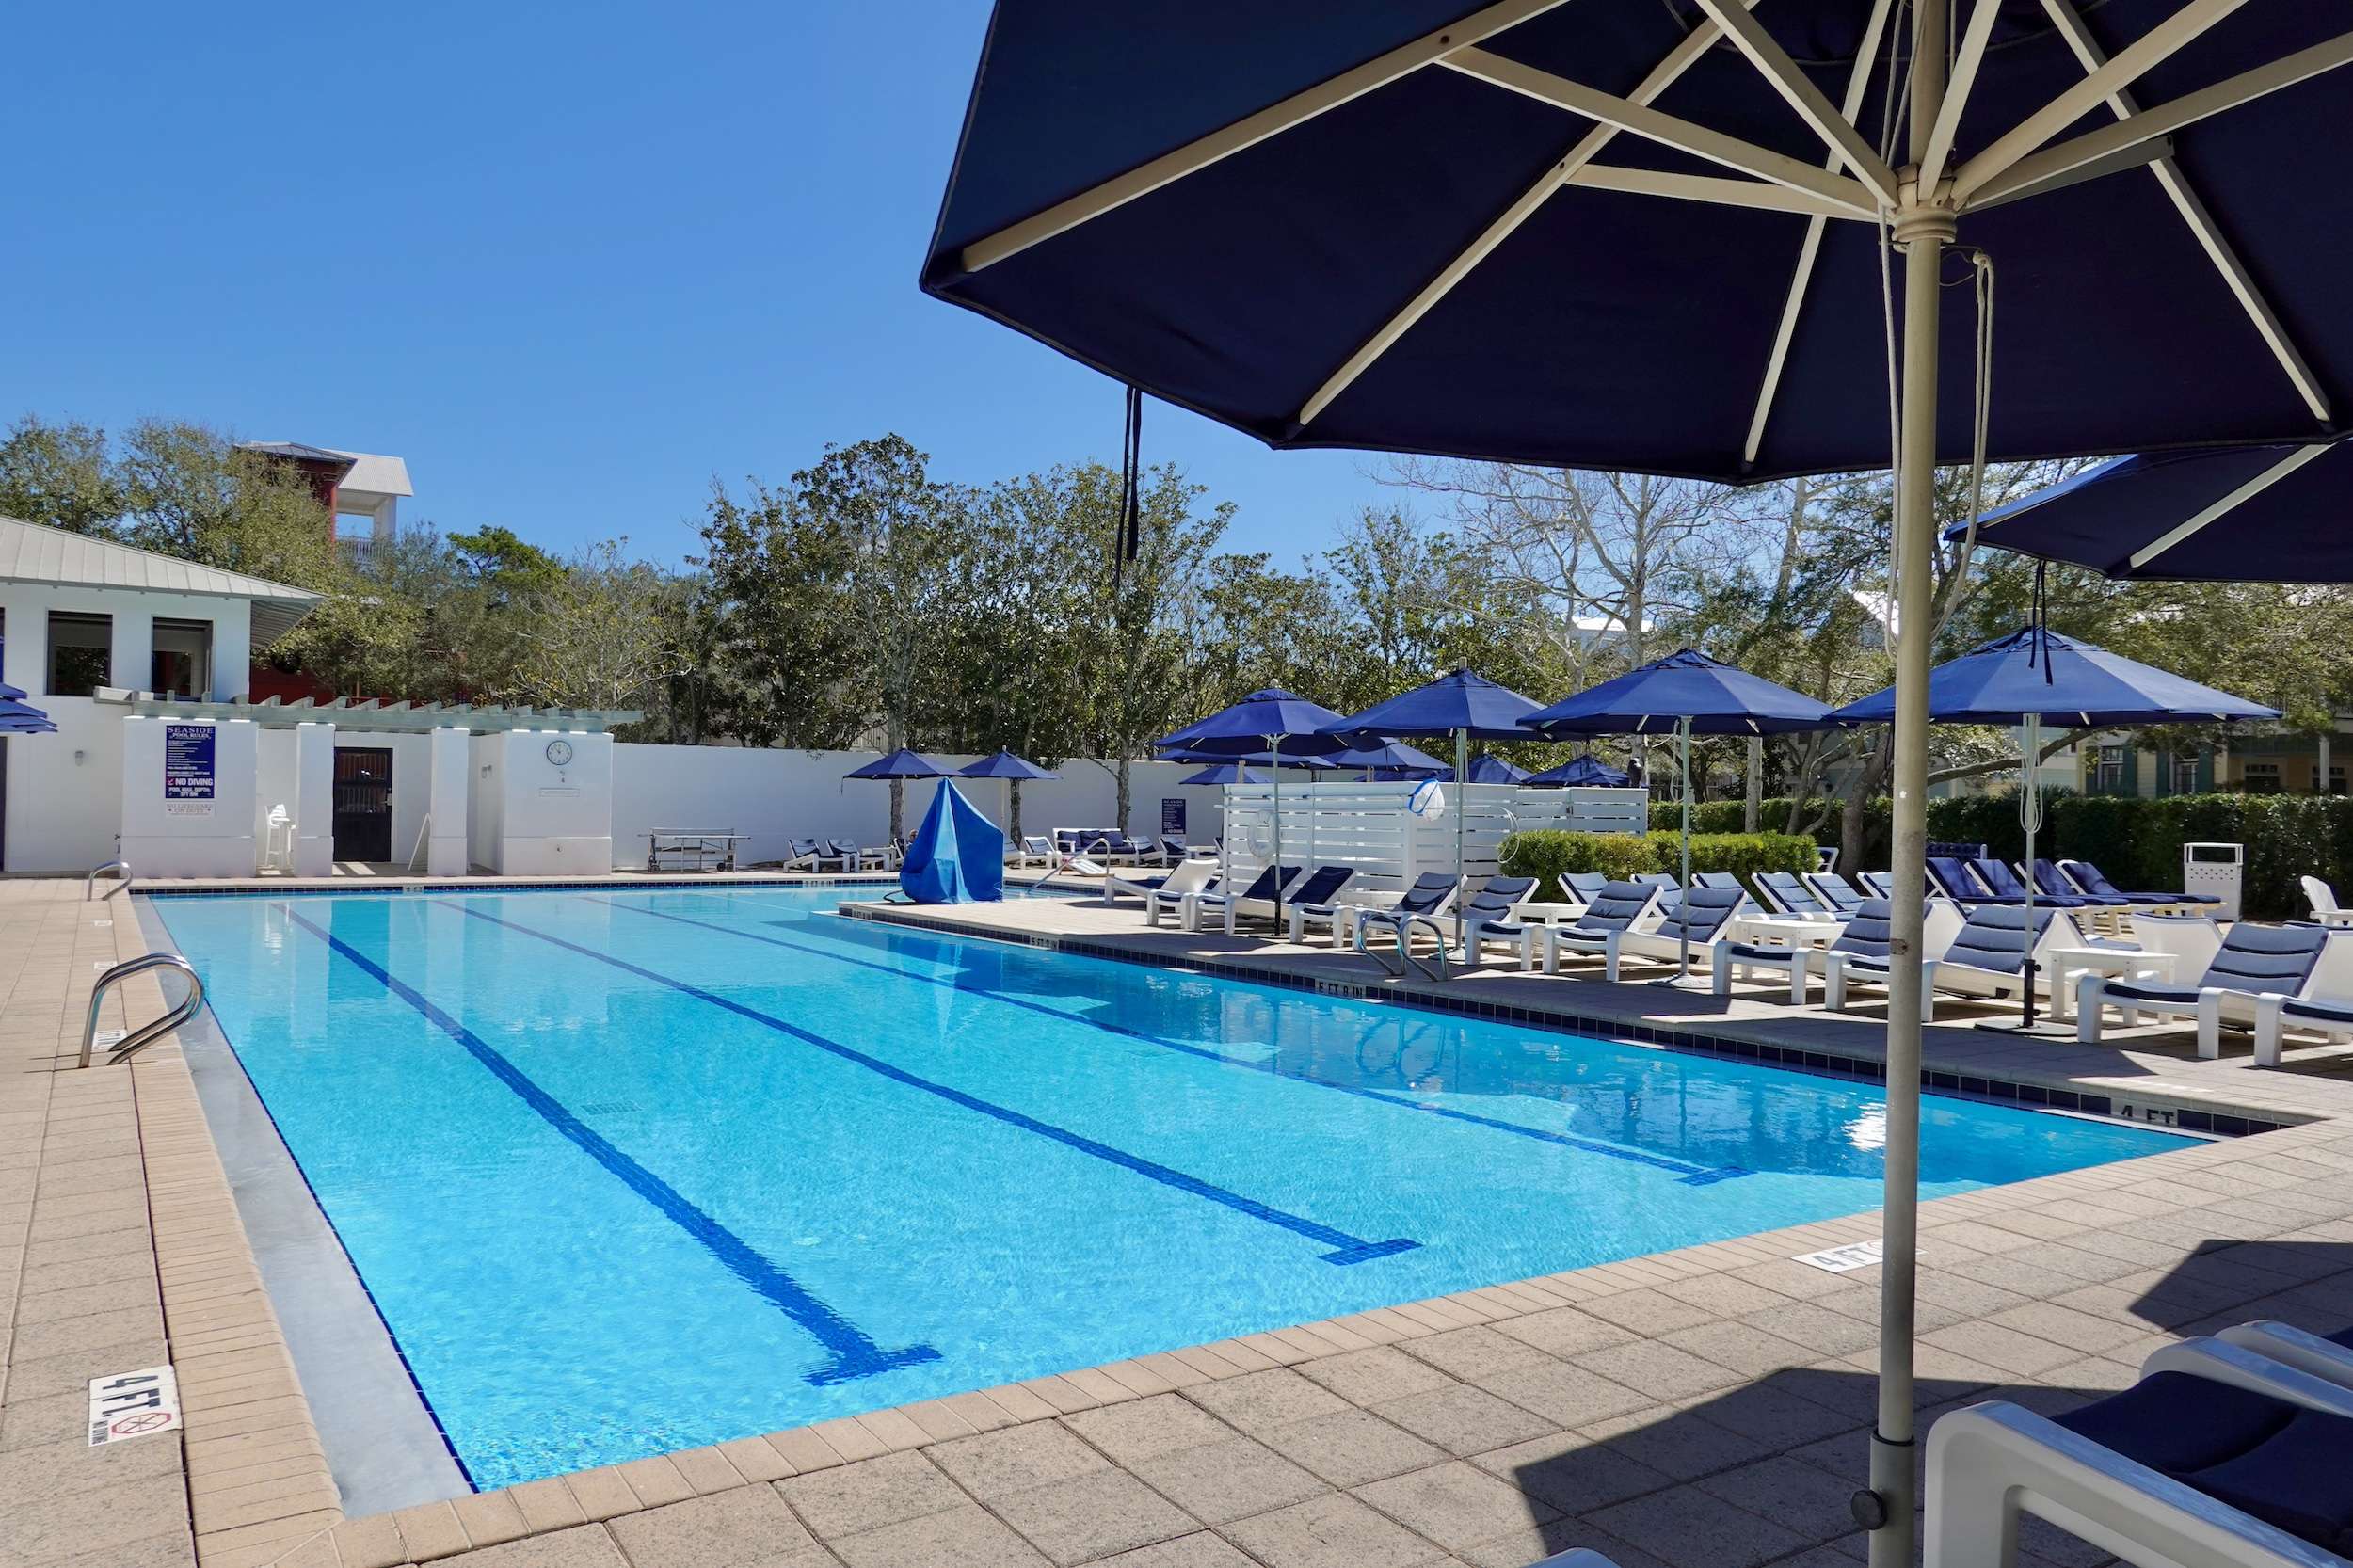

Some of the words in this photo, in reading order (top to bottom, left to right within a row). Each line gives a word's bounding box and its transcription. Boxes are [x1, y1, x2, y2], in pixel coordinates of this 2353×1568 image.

[2146, 1108, 2175, 1124] FT
[1811, 1254, 1849, 1267] 4
[102, 1375, 159, 1390] 4
